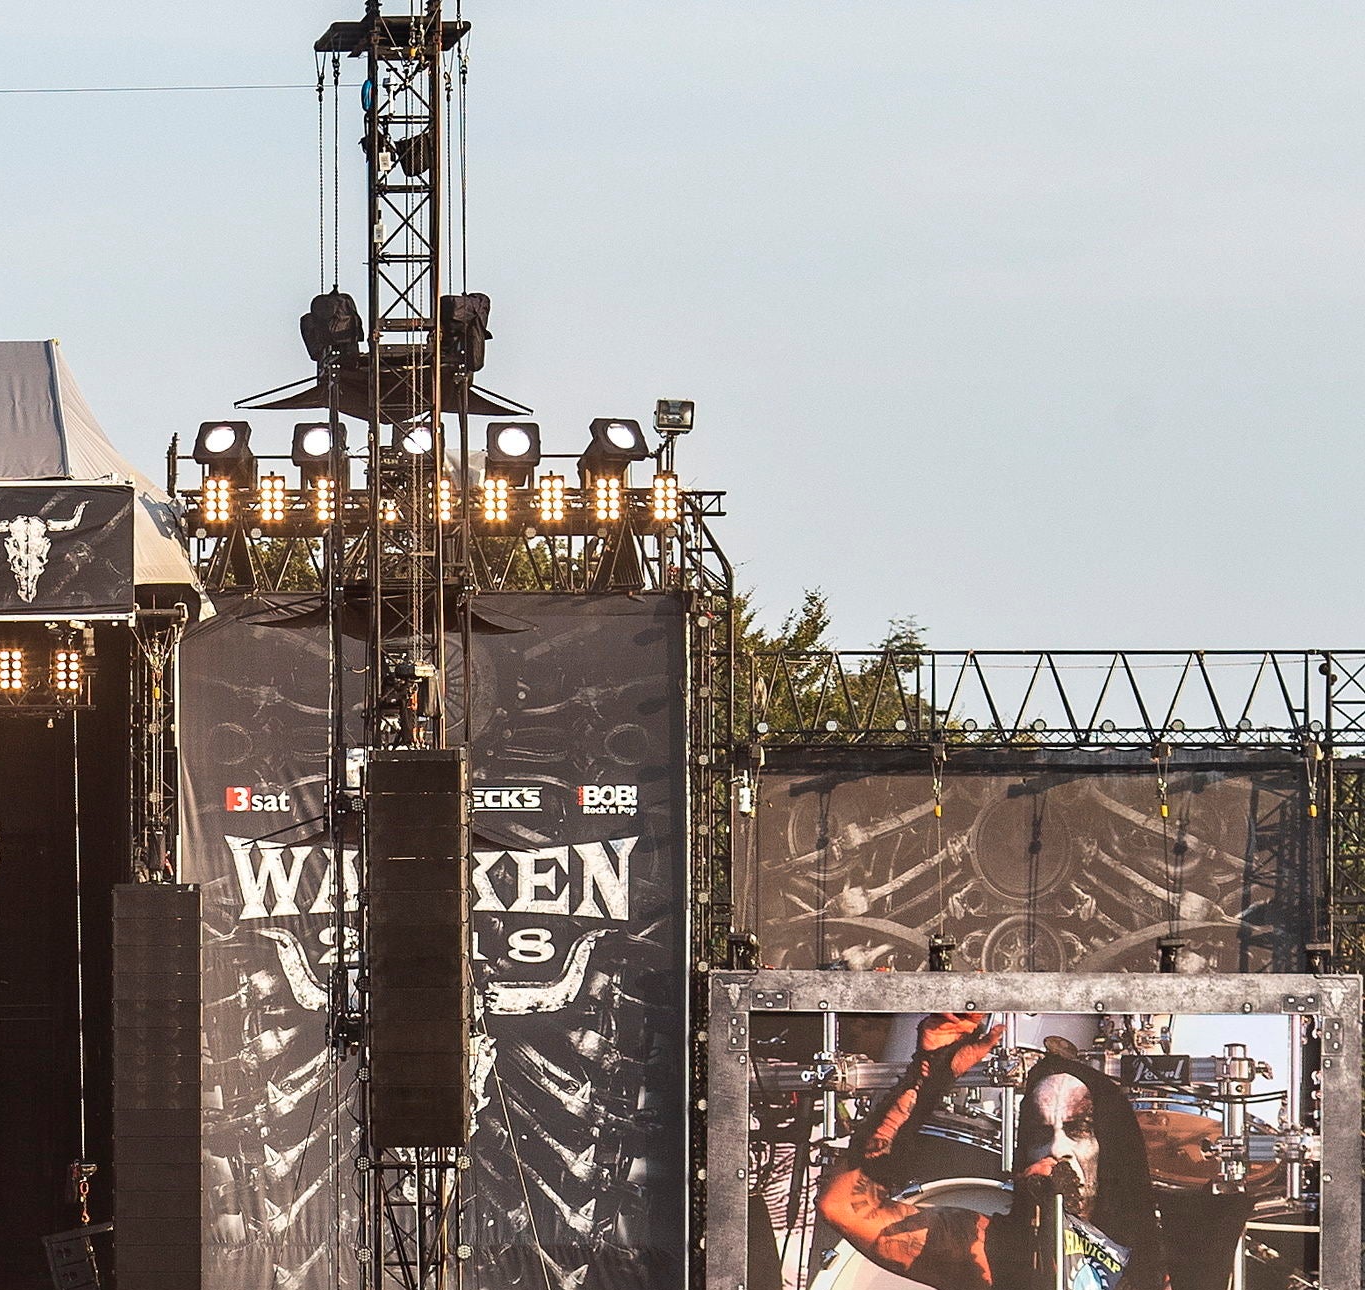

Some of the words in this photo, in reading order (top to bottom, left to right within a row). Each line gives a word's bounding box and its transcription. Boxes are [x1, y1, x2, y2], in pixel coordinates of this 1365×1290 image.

[472, 788, 541, 809] ECK'S
[583, 785, 638, 805] BOB!
[582, 805, 614, 815] Rock'n
[617, 805, 637, 817] Pop
